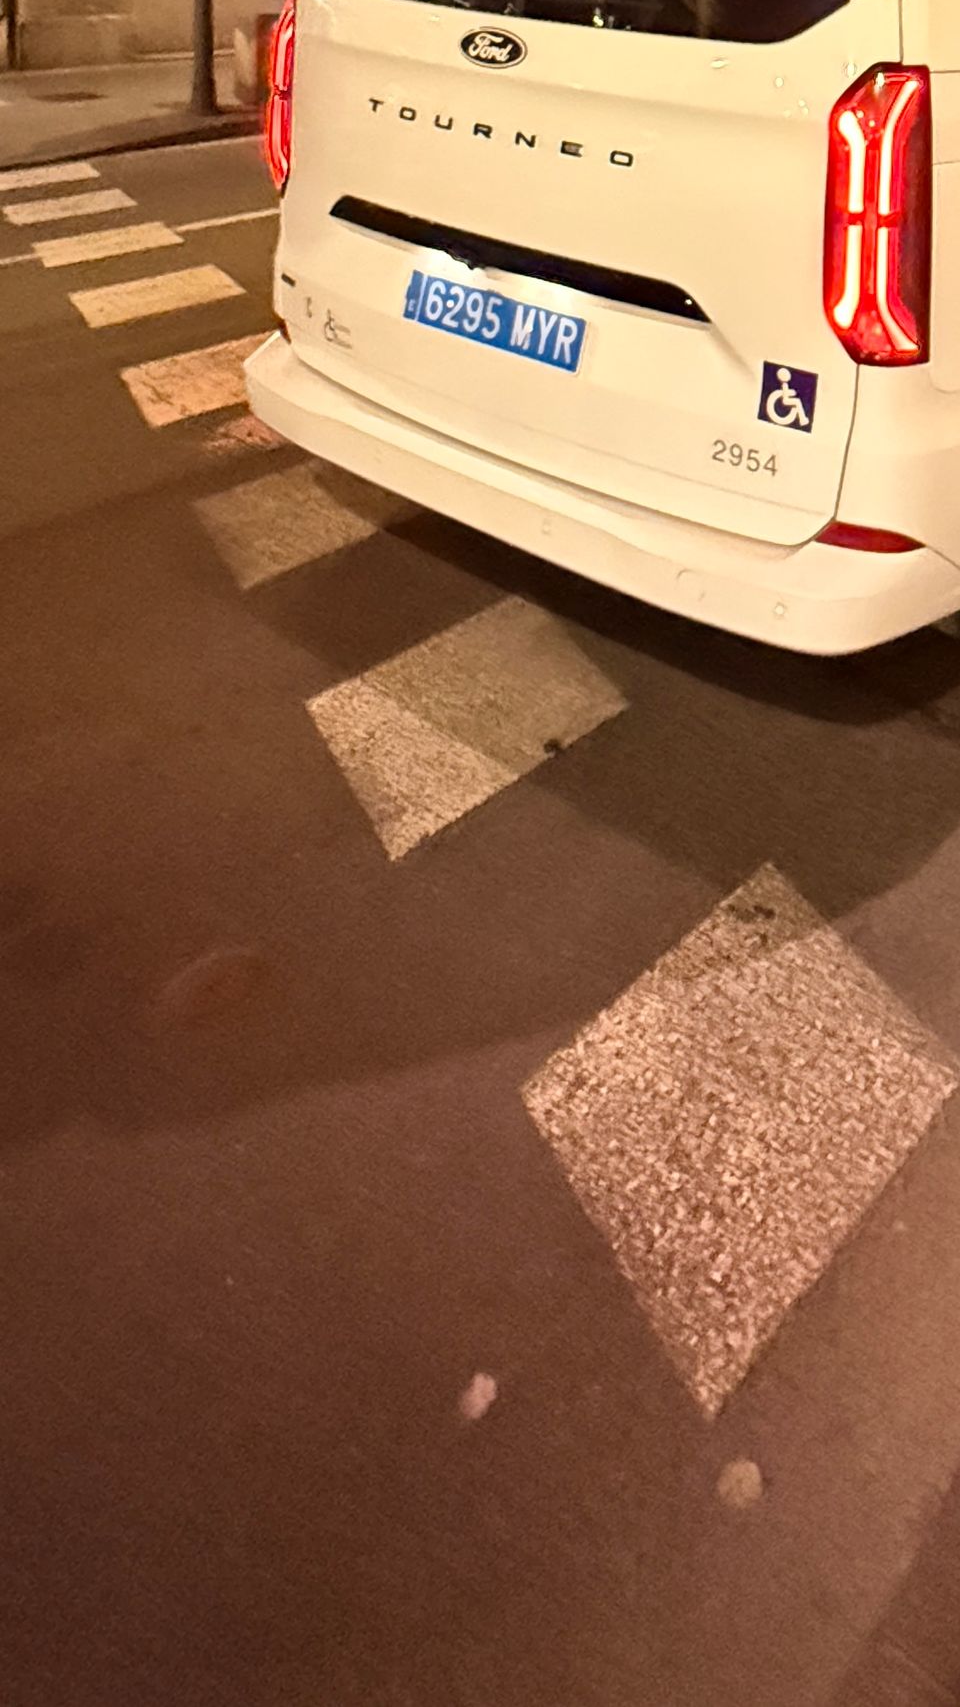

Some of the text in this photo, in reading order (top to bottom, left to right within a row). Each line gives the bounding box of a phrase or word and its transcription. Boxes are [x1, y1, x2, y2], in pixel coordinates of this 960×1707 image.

[471, 33, 511, 62] Ford
[369, 98, 634, 167] TOURNEO
[425, 280, 578, 364] 6295 MYR
[711, 439, 778, 477] 2954
